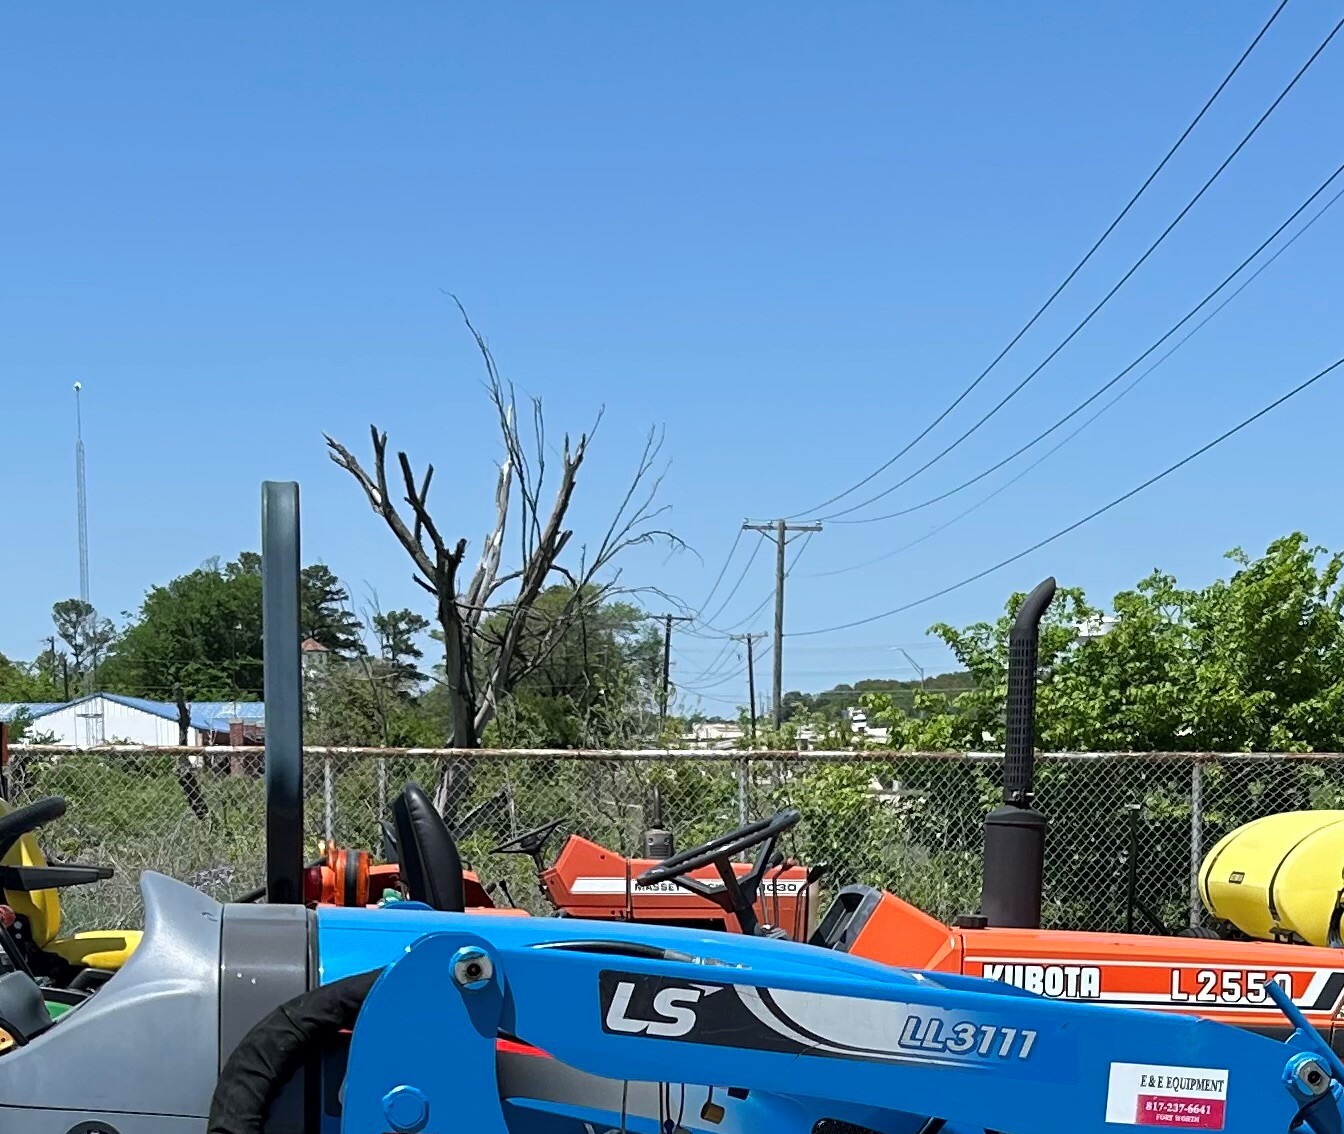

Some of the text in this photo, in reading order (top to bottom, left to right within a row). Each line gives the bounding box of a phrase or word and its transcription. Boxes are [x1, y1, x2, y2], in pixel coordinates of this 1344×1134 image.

[605, 981, 723, 1038] LS
[898, 1015, 1037, 1060] LL3111
[1140, 1075, 1224, 1092] E & E EQUIPMENT
